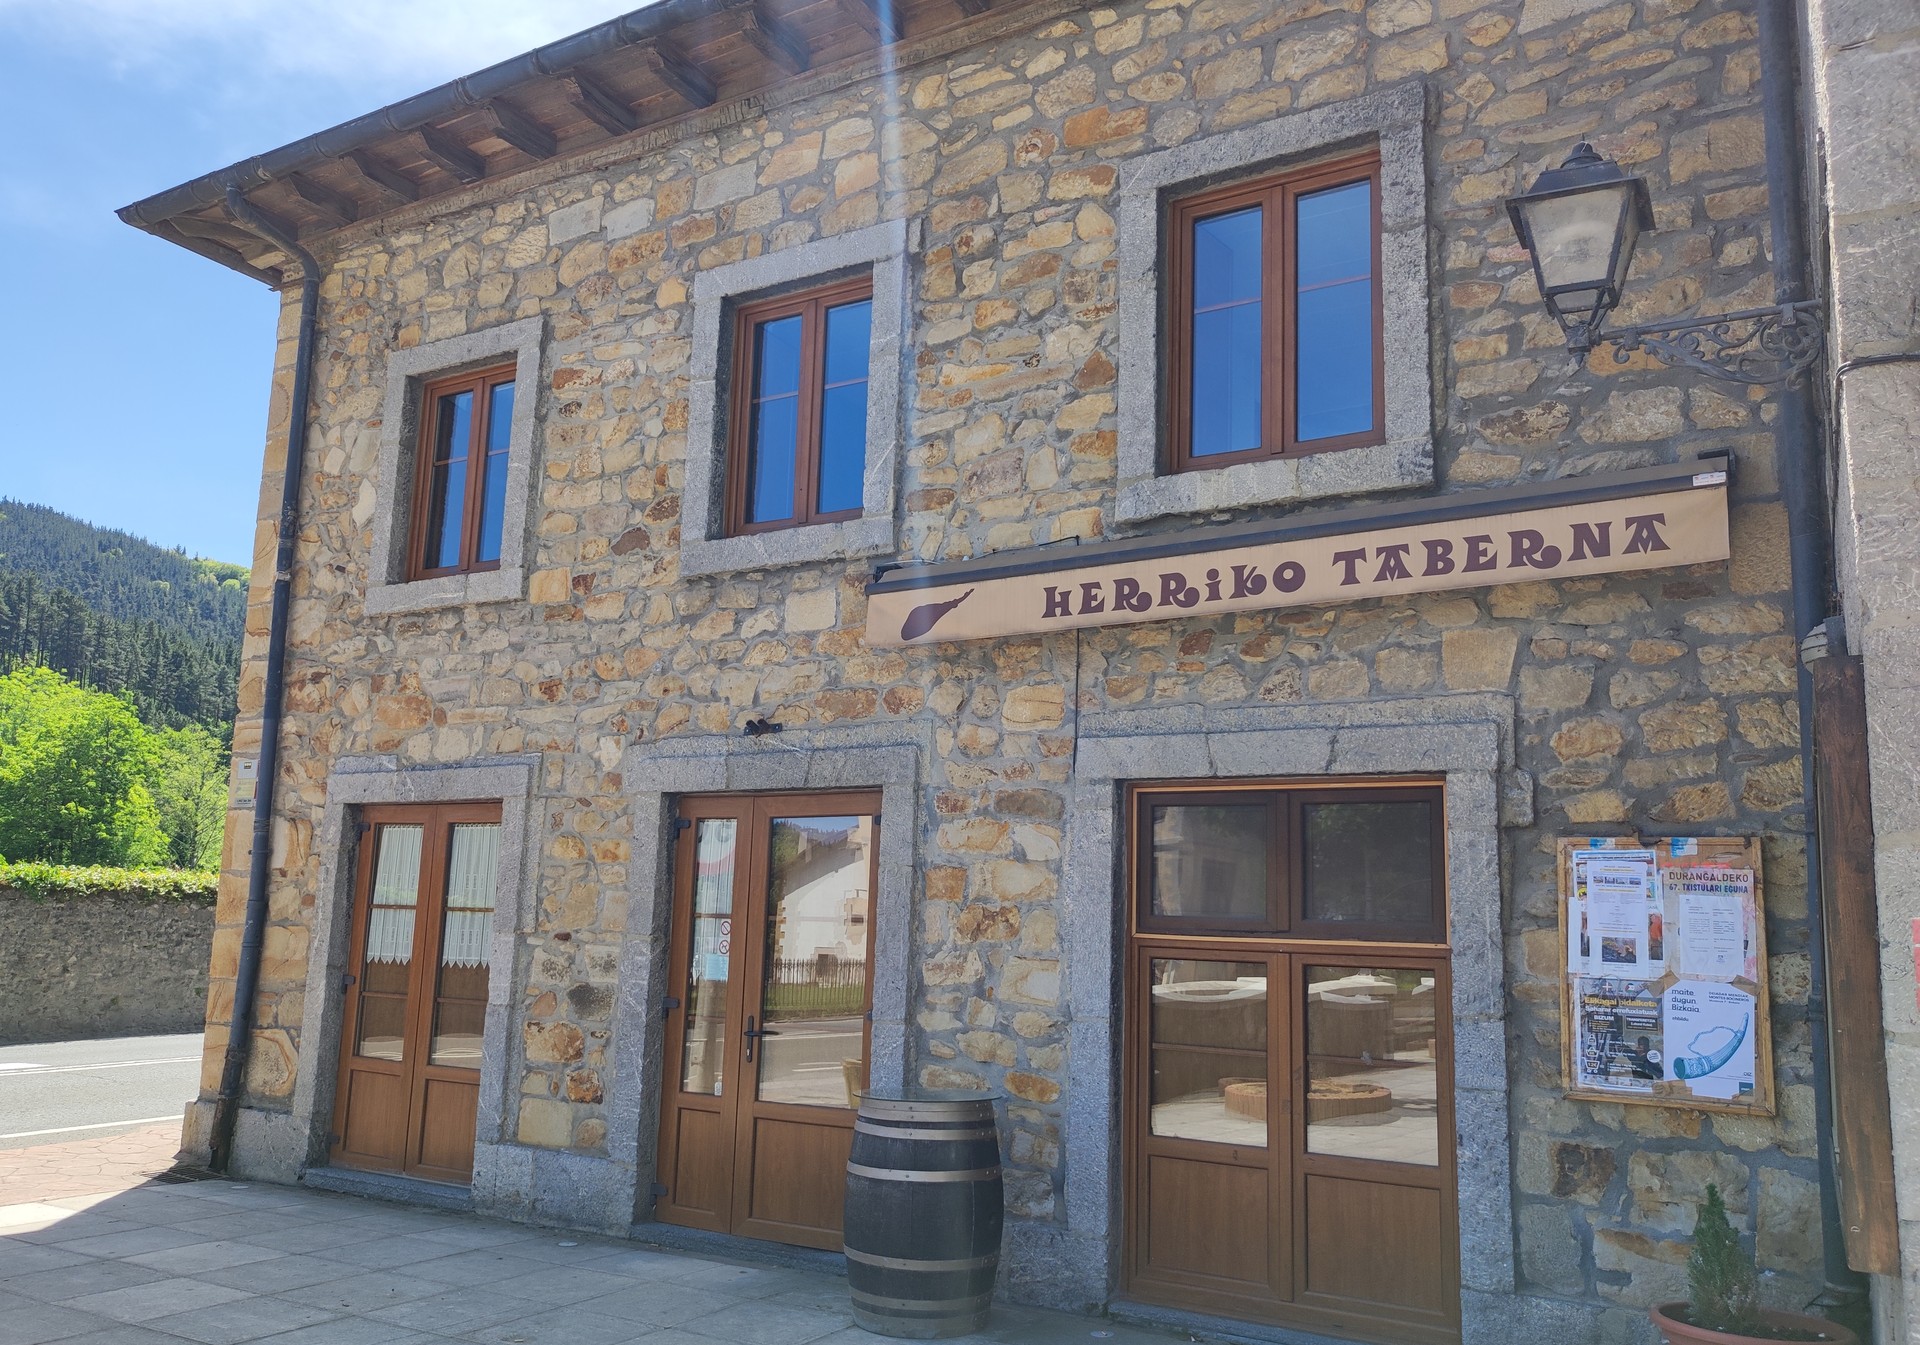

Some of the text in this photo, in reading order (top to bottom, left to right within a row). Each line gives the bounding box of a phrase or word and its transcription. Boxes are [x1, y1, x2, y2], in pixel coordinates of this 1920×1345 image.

[1331, 512, 1671, 586] TABERNA
[1669, 871, 1748, 882] DURANGALDEKO
[1669, 883, 1748, 893] 67. TXISTULARI EGUNA
[1671, 988, 1694, 996] maite
[1671, 996, 1697, 1004] dugun
[1671, 1003, 1700, 1012] Bizkaia
